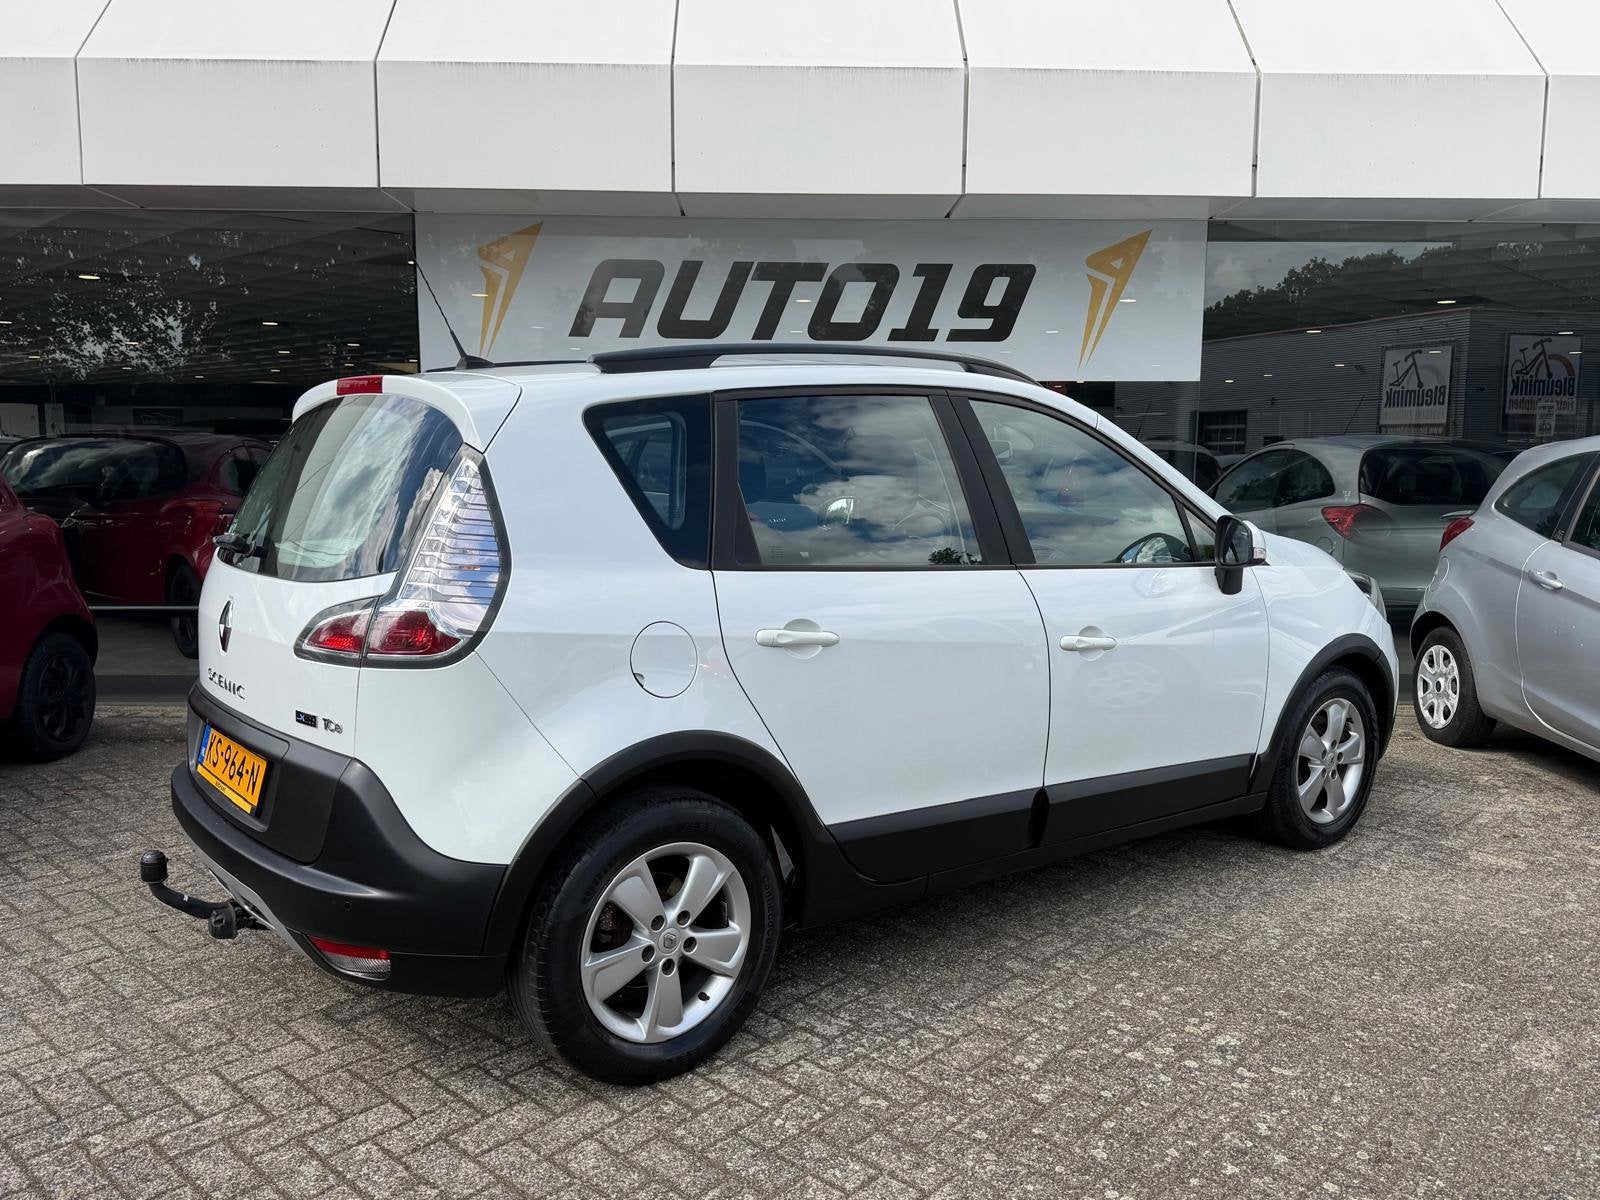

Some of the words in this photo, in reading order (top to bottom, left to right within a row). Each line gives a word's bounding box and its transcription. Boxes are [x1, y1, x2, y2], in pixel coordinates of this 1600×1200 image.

[568, 258, 1037, 342] AUTO19
[208, 667, 245, 699] SCENIC
[206, 733, 260, 796] KS-964-N
